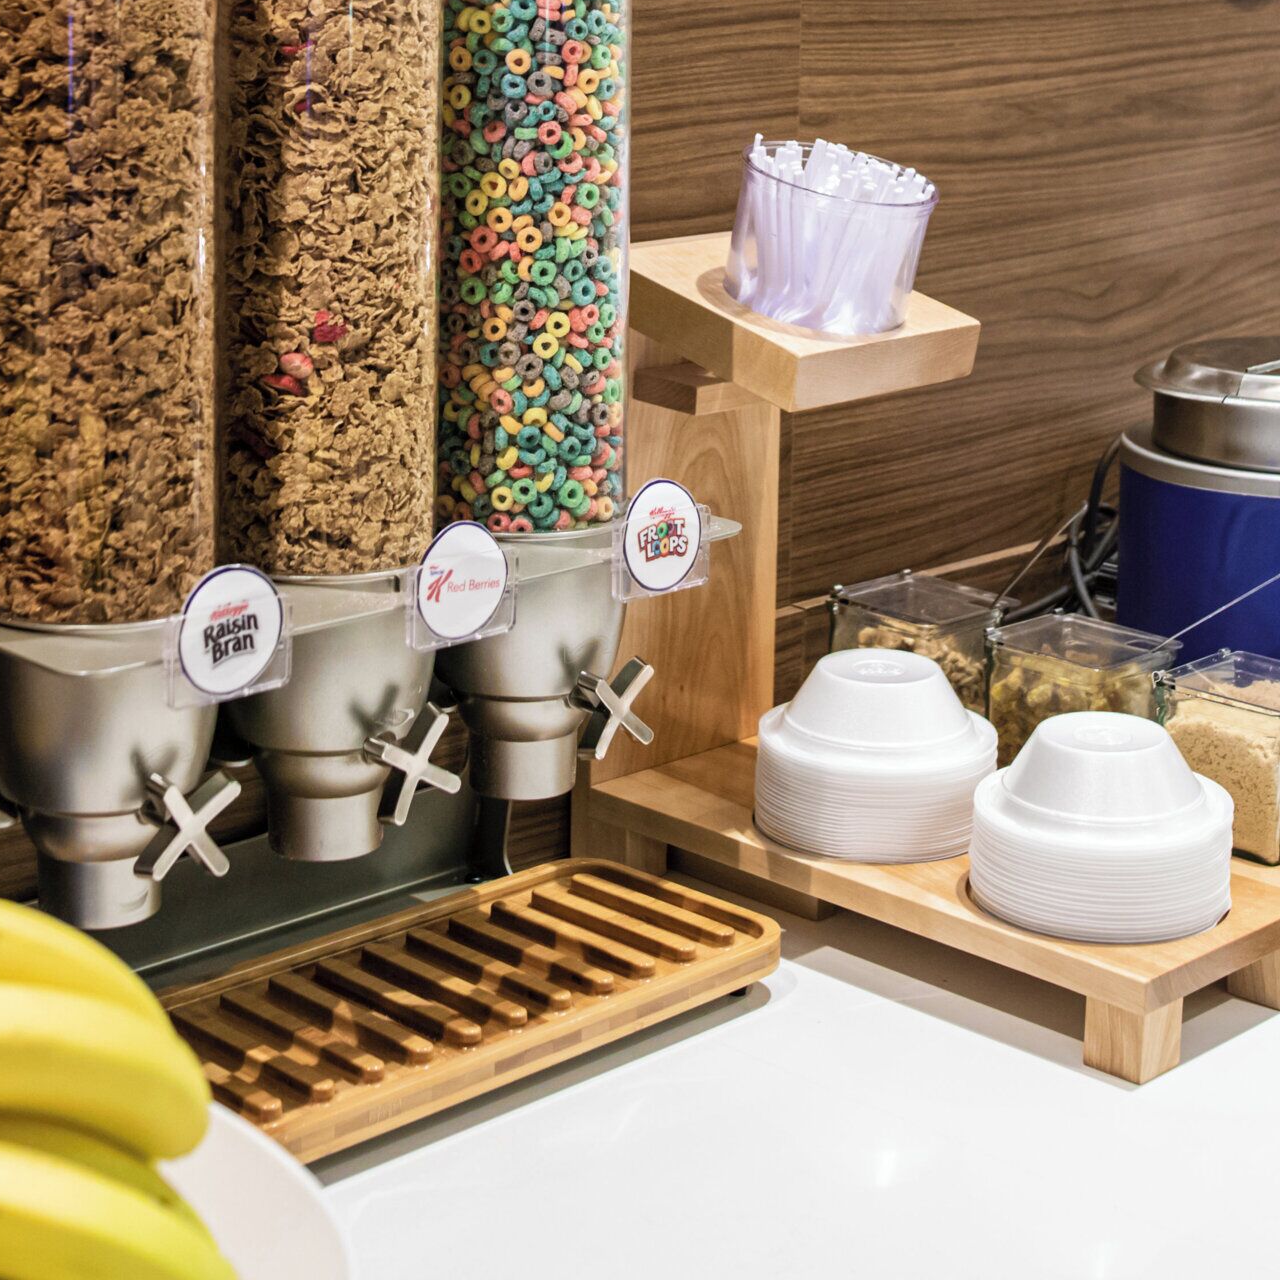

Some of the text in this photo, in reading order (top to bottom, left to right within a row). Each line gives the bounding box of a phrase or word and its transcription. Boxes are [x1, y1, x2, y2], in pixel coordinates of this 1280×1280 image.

[638, 518, 686, 552] FROOT
[645, 535, 689, 562] LOOPS
[447, 580, 467, 593] Red
[469, 578, 500, 592] Berries
[203, 612, 259, 649] Raisin
[212, 633, 255, 665] Bran
